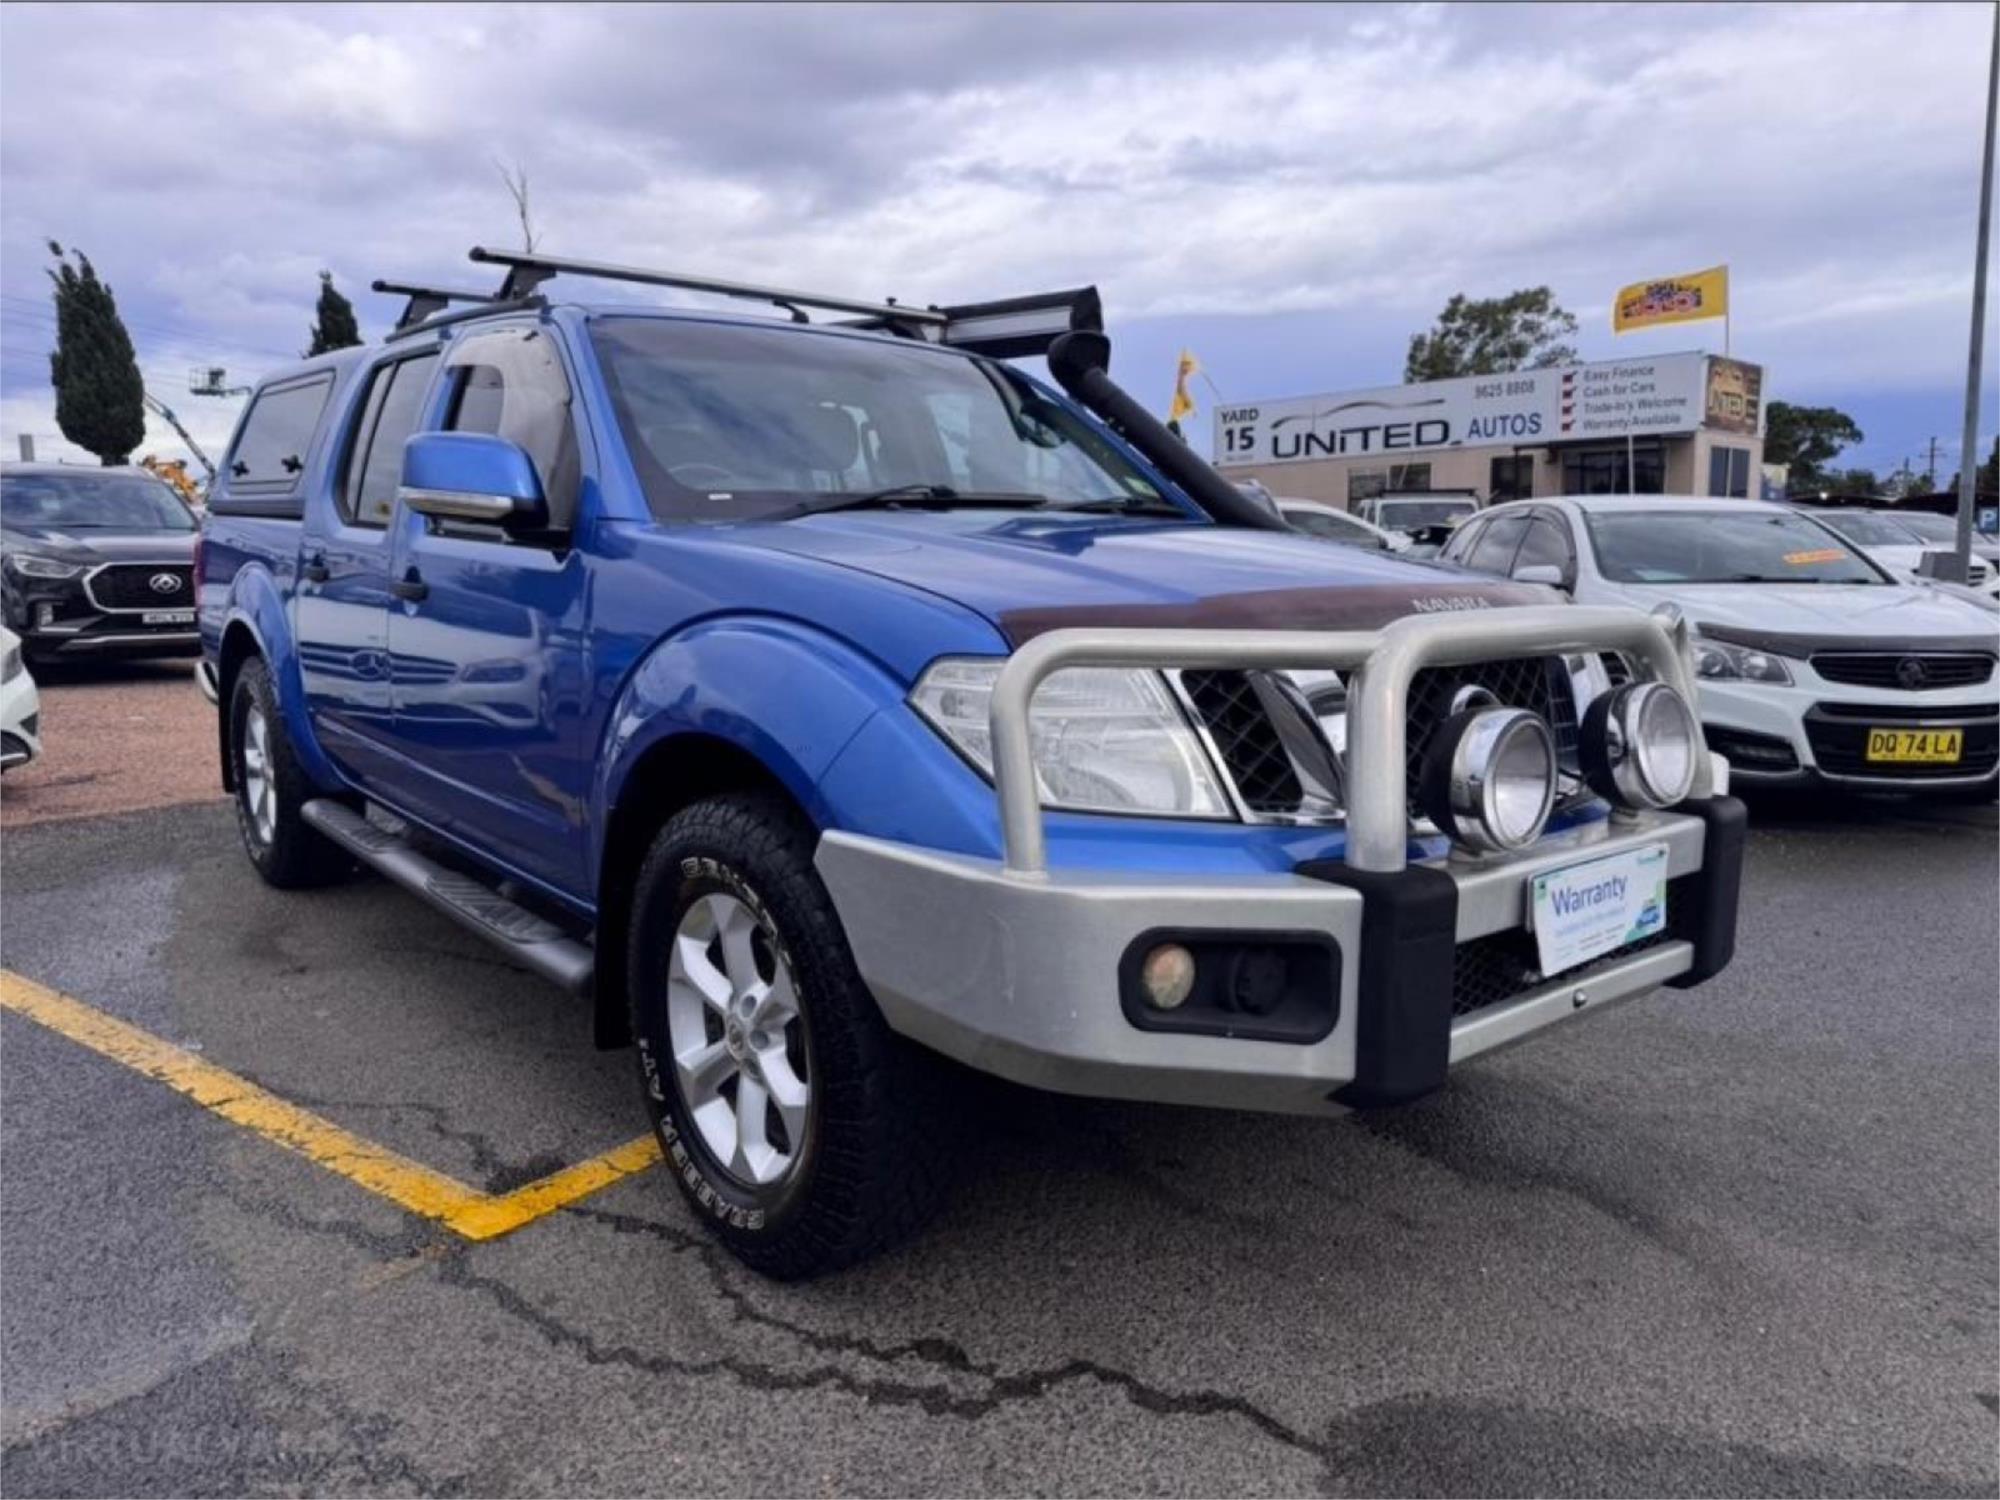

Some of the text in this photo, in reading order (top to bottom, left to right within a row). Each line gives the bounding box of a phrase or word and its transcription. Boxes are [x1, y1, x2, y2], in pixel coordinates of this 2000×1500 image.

[1584, 366, 1655, 381] Easy Finance
[1583, 382, 1655, 397] Cash for Cars
[1638, 398, 1687, 409] Welcome
[1221, 407, 1260, 424] YARD
[1583, 415, 1681, 431] Warranty Available
[1468, 412, 1543, 439] AUTOS
[1225, 426, 1255, 451] 15
[1980, 509, 1996, 529] P
[1905, 733, 1928, 753] 74
[1934, 733, 1956, 753] LA
[1552, 873, 1628, 917] Warranty
